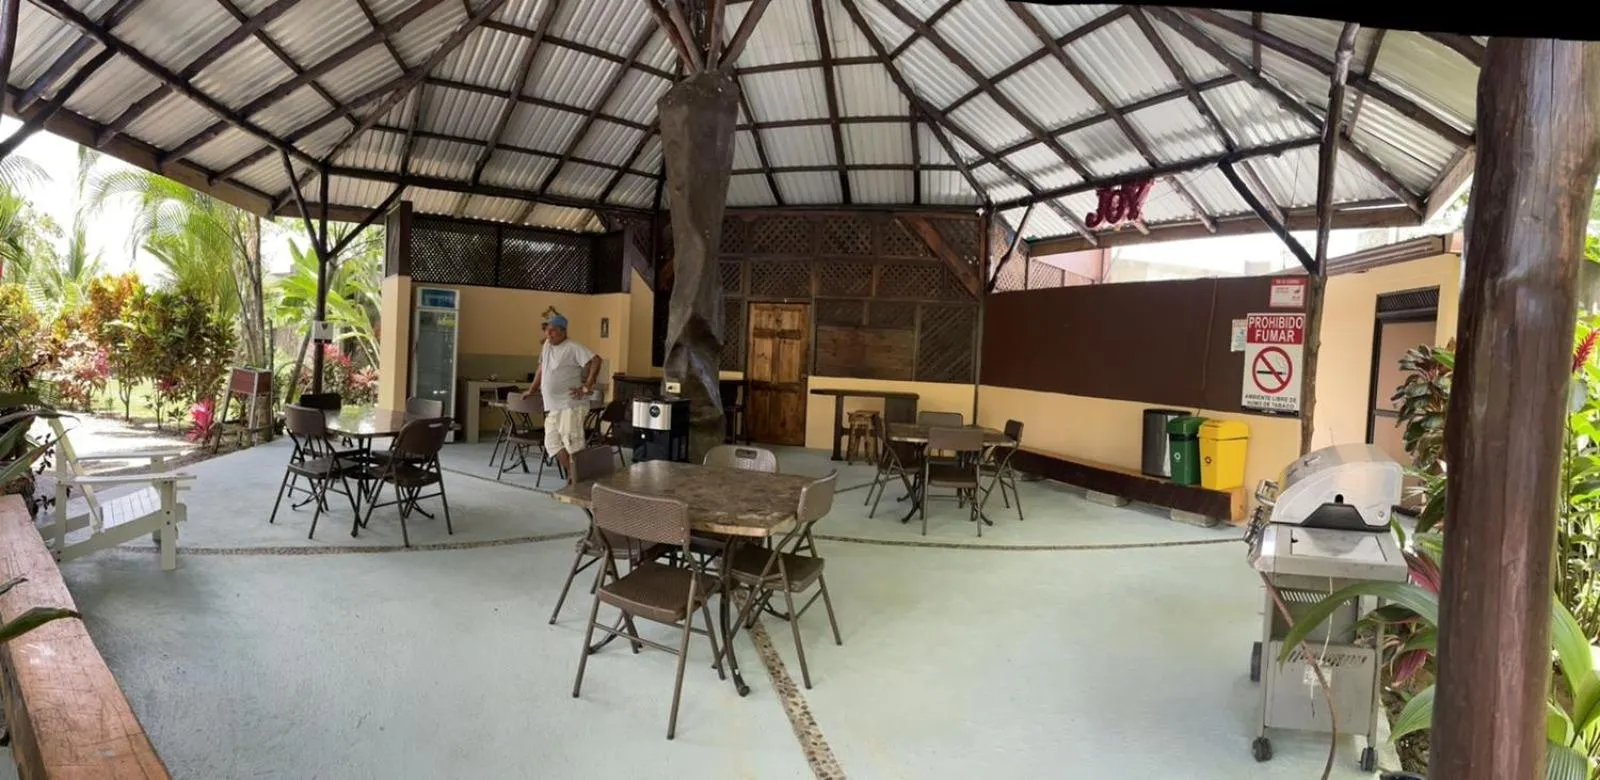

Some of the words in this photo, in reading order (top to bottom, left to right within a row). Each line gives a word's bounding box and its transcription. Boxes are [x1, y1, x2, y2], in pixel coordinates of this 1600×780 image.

[1085, 178, 1153, 228] JOY
[1249, 317, 1303, 329] PROHIBIDO
[1255, 329, 1295, 342] FUMAR
